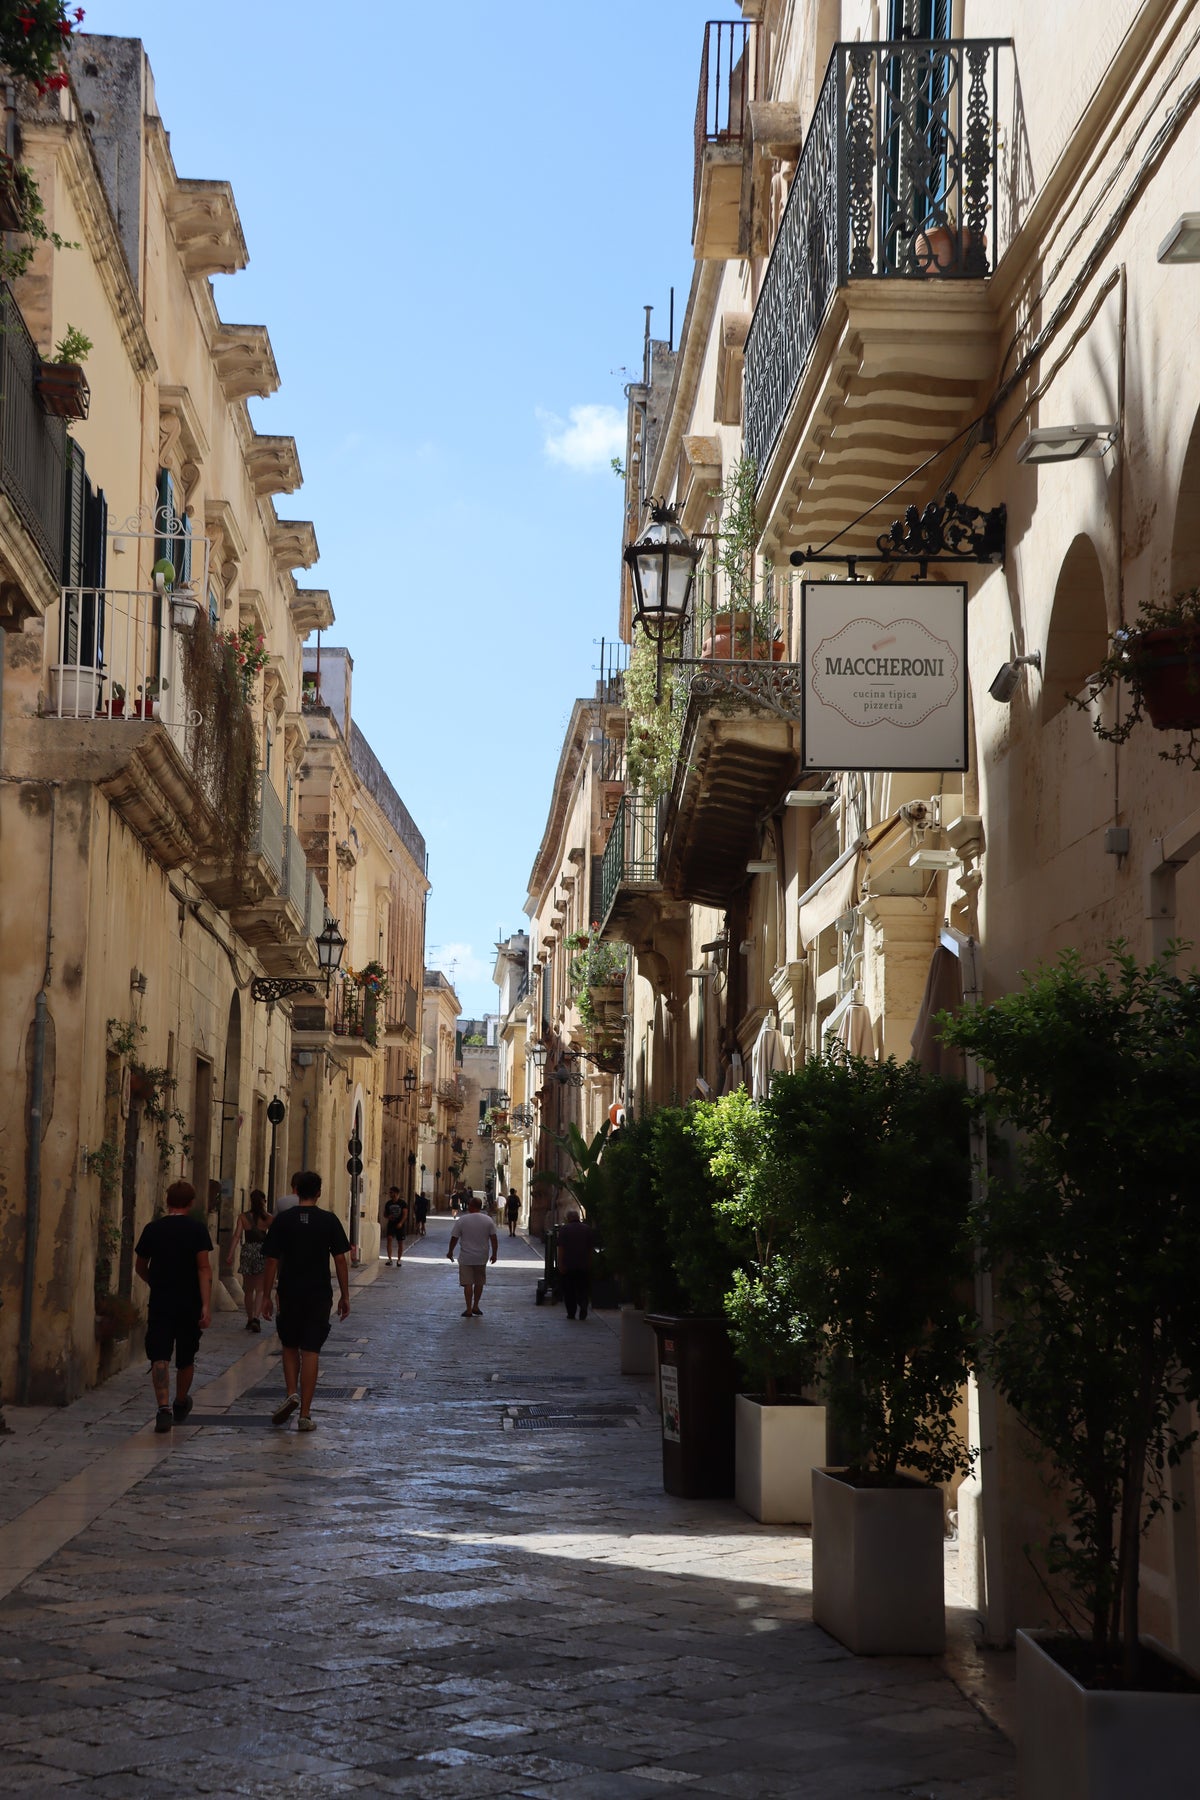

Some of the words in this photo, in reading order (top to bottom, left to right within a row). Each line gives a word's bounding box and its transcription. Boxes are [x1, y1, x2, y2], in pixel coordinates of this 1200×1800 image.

[825, 657, 944, 677] MACCHERONI
[853, 689, 886, 699] cucina
[889, 689, 917, 701] tipica
[863, 701, 904, 712] pizzeria
